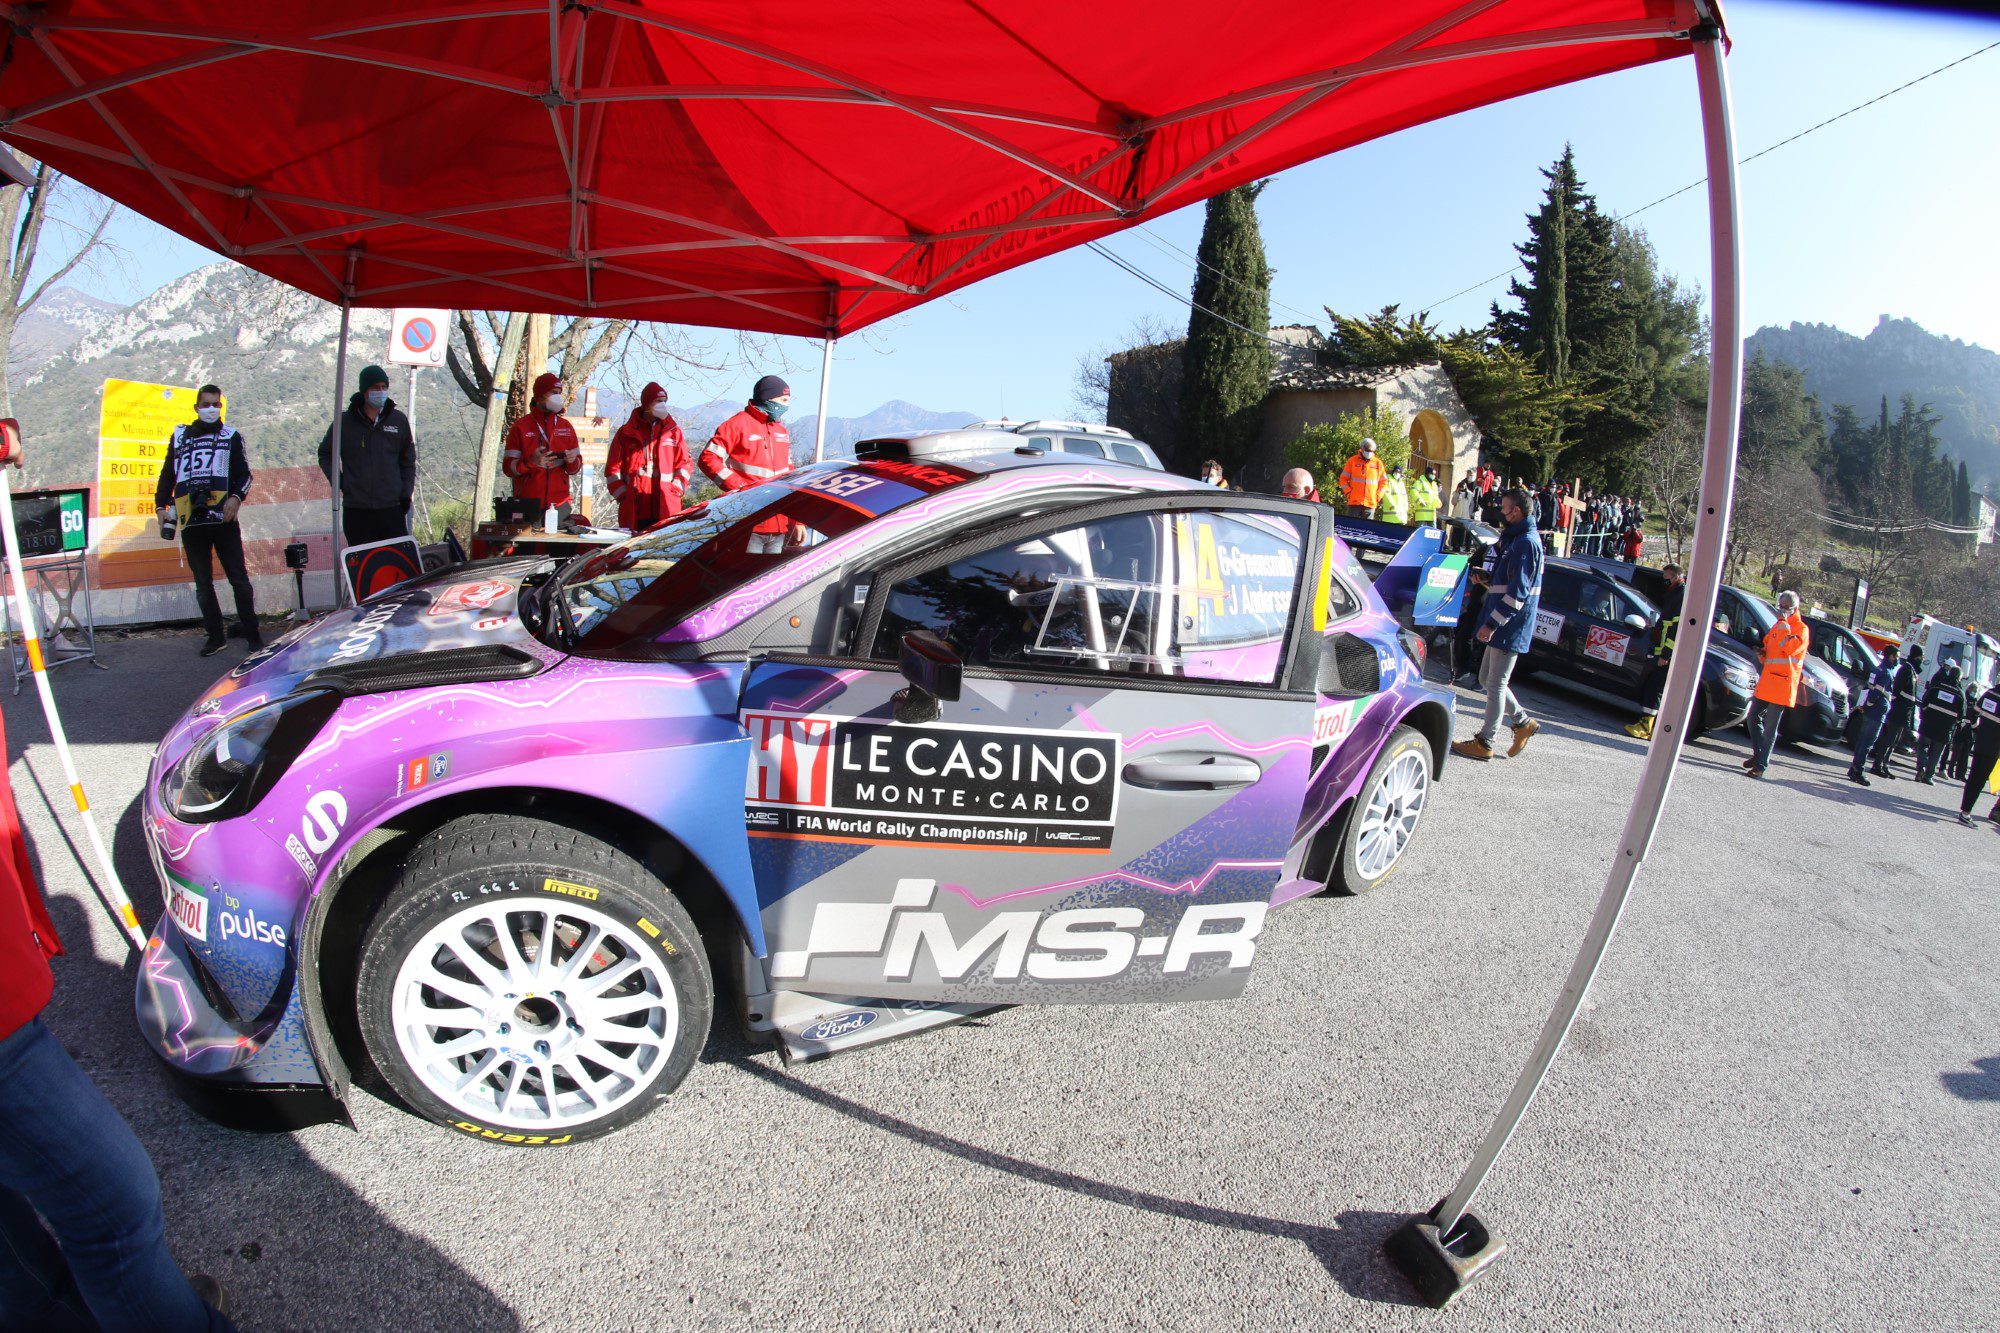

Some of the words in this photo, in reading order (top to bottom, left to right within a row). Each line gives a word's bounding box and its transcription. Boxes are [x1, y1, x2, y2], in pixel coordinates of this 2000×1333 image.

[139, 445, 156, 456] RD
[183, 451, 215, 473] 257
[111, 463, 155, 476] ROUTE
[61, 509, 83, 533] GO
[108, 503, 127, 515] DE
[842, 732, 894, 774] LE
[905, 737, 1108, 786] CASINO
[856, 782, 966, 807] MONTE
[989, 791, 1090, 813] CARLO
[796, 815, 823, 830] FIA
[826, 817, 872, 833] World
[876, 820, 916, 839] Rally
[920, 822, 1028, 843] Championship
[287, 835, 319, 882] sparco
[225, 892, 240, 911] bp
[543, 878, 600, 901] PIRELLI
[220, 908, 287, 949] pulse
[883, 900, 1269, 980] MS-R
[661, 937, 678, 956] WRC
[808, 1013, 871, 1040] Ford
